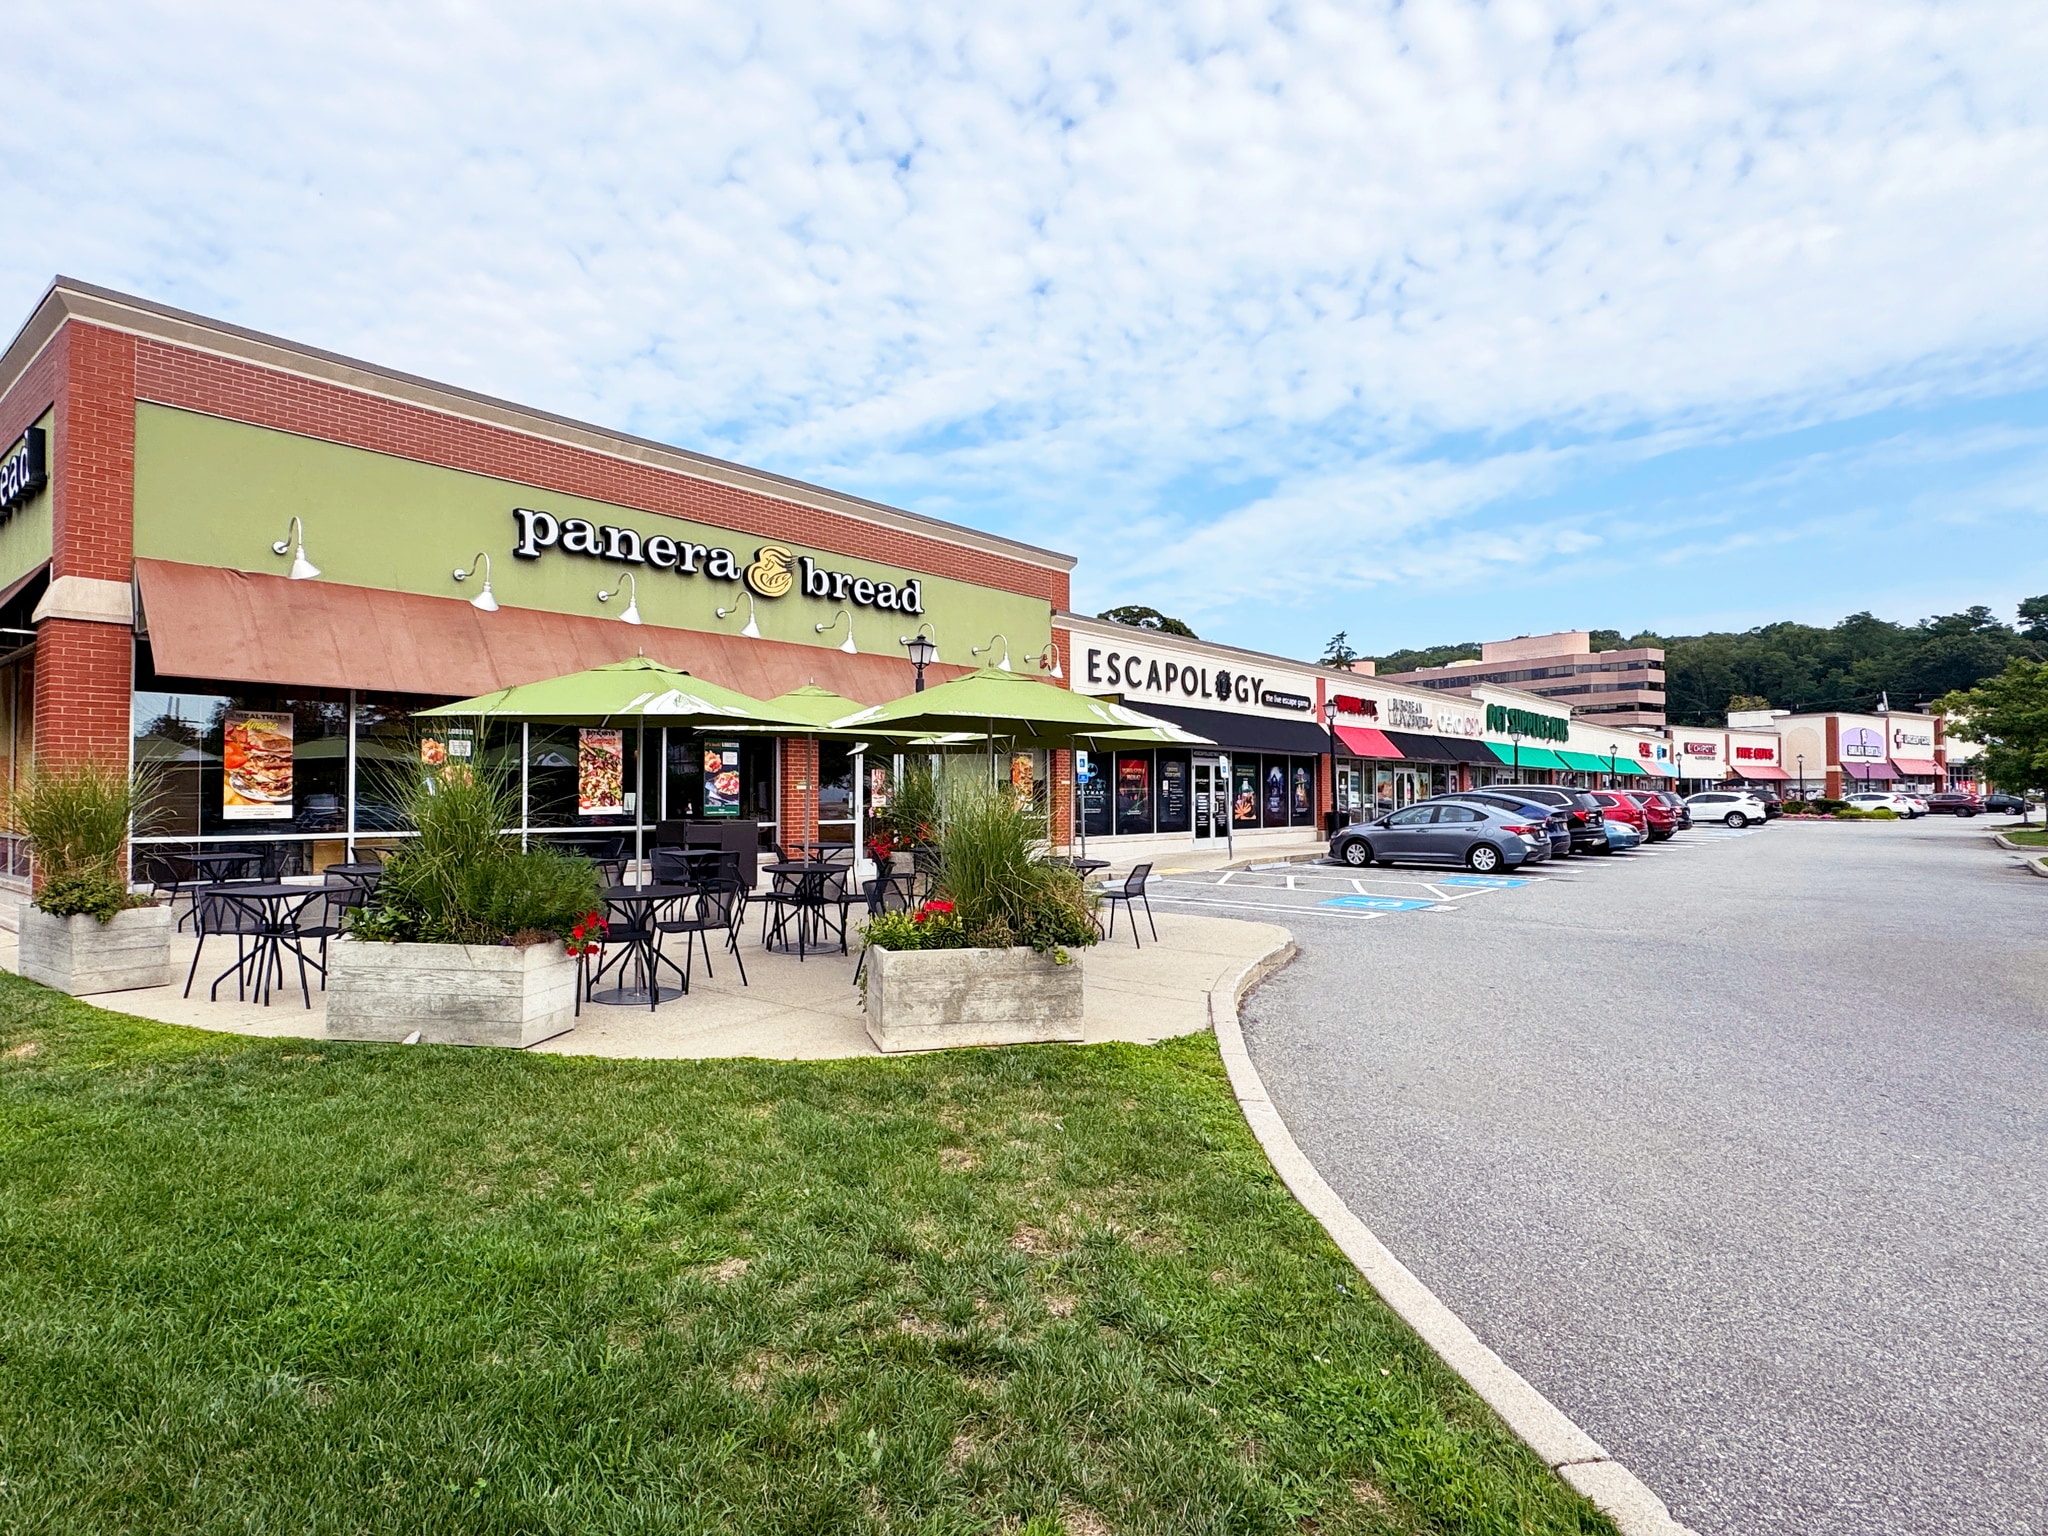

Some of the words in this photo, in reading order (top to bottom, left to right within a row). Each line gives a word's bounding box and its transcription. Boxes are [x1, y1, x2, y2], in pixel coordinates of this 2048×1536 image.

[513, 508, 741, 581] panera
[802, 556, 925, 614] bread
[1282, 697, 1297, 707] escape
[1487, 703, 1507, 733] PET
[1507, 708, 1549, 739] SUPPLIES
[1549, 716, 1570, 743] PLUS
[1736, 746, 1753, 759] FIVE
[1753, 747, 1774, 760] GUYS
